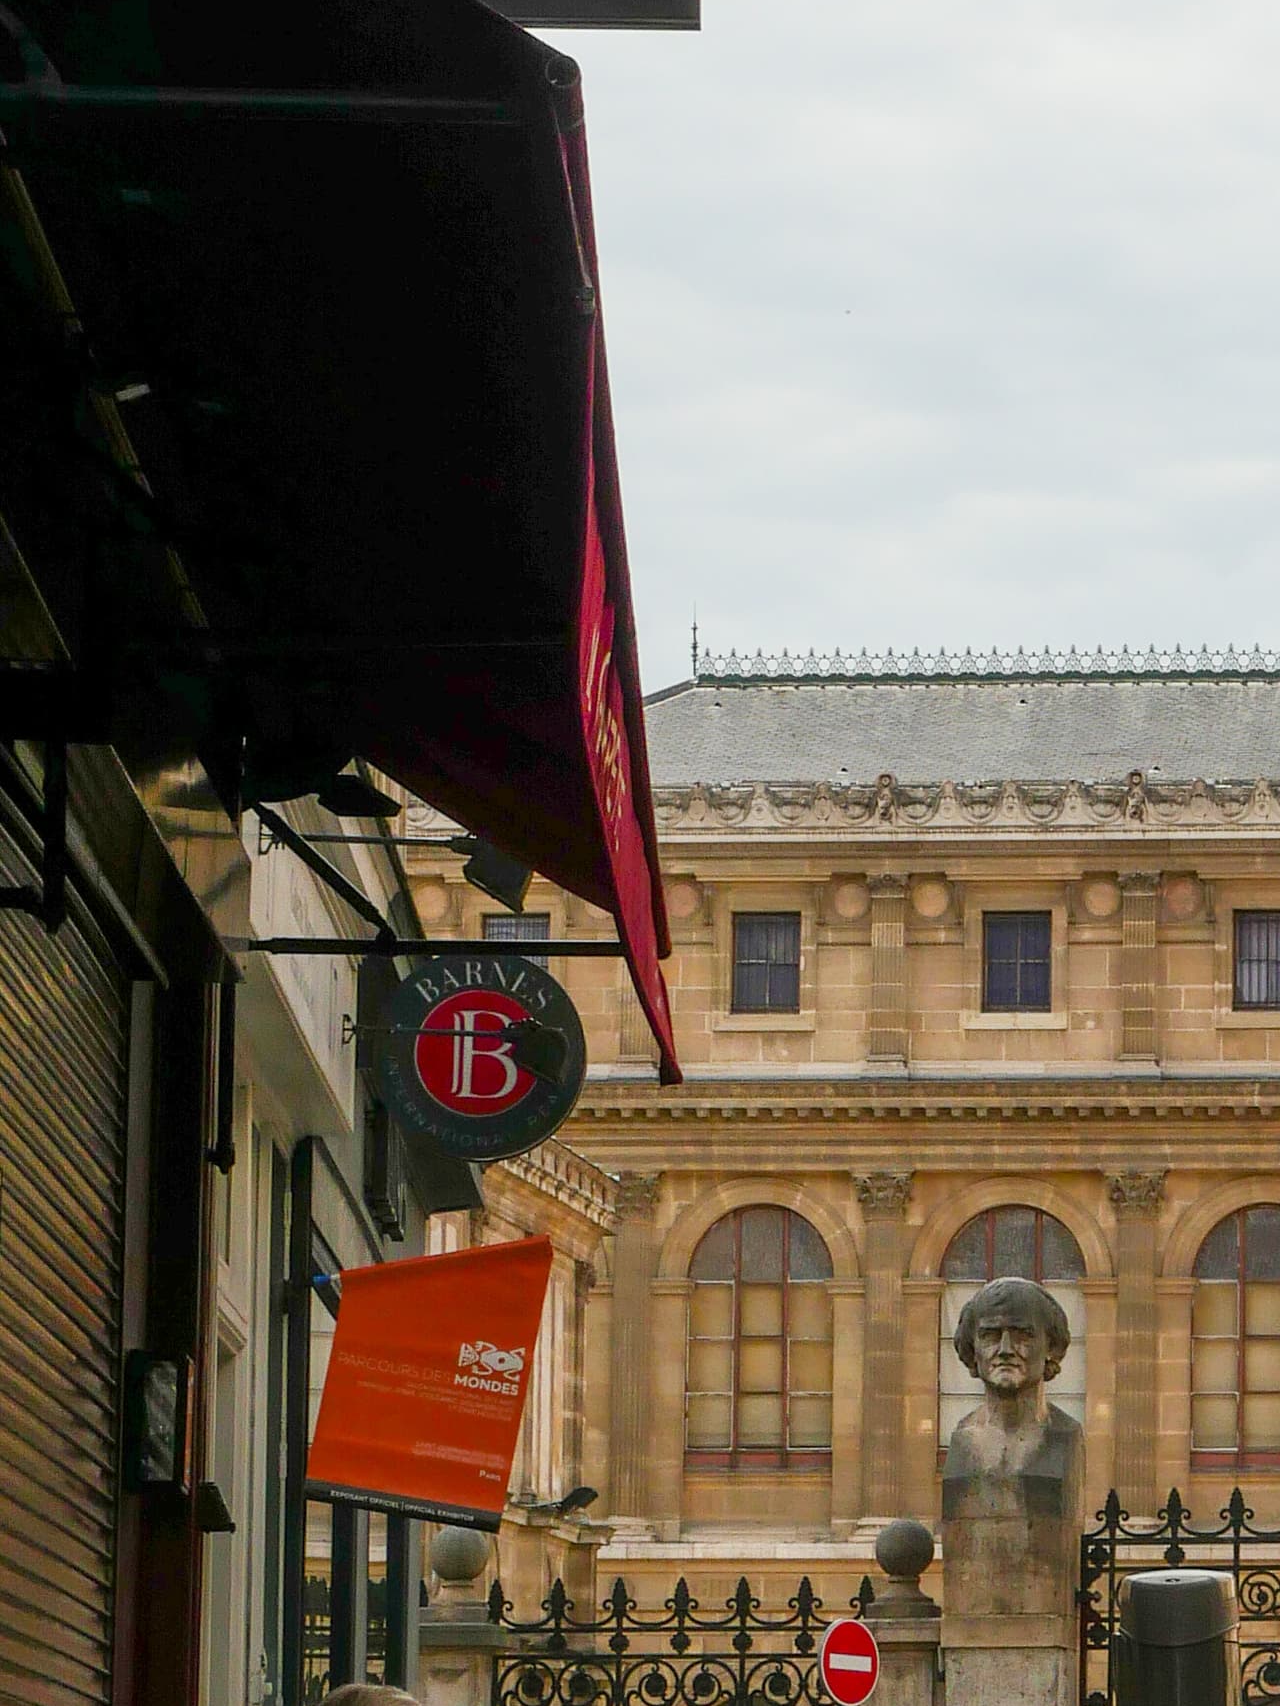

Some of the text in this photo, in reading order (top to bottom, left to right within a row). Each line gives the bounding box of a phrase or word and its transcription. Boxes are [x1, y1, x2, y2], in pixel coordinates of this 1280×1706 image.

[414, 960, 551, 1011] BARNES
[337, 1351, 420, 1379] PARCOURS
[454, 1373, 519, 1397] MONDES
